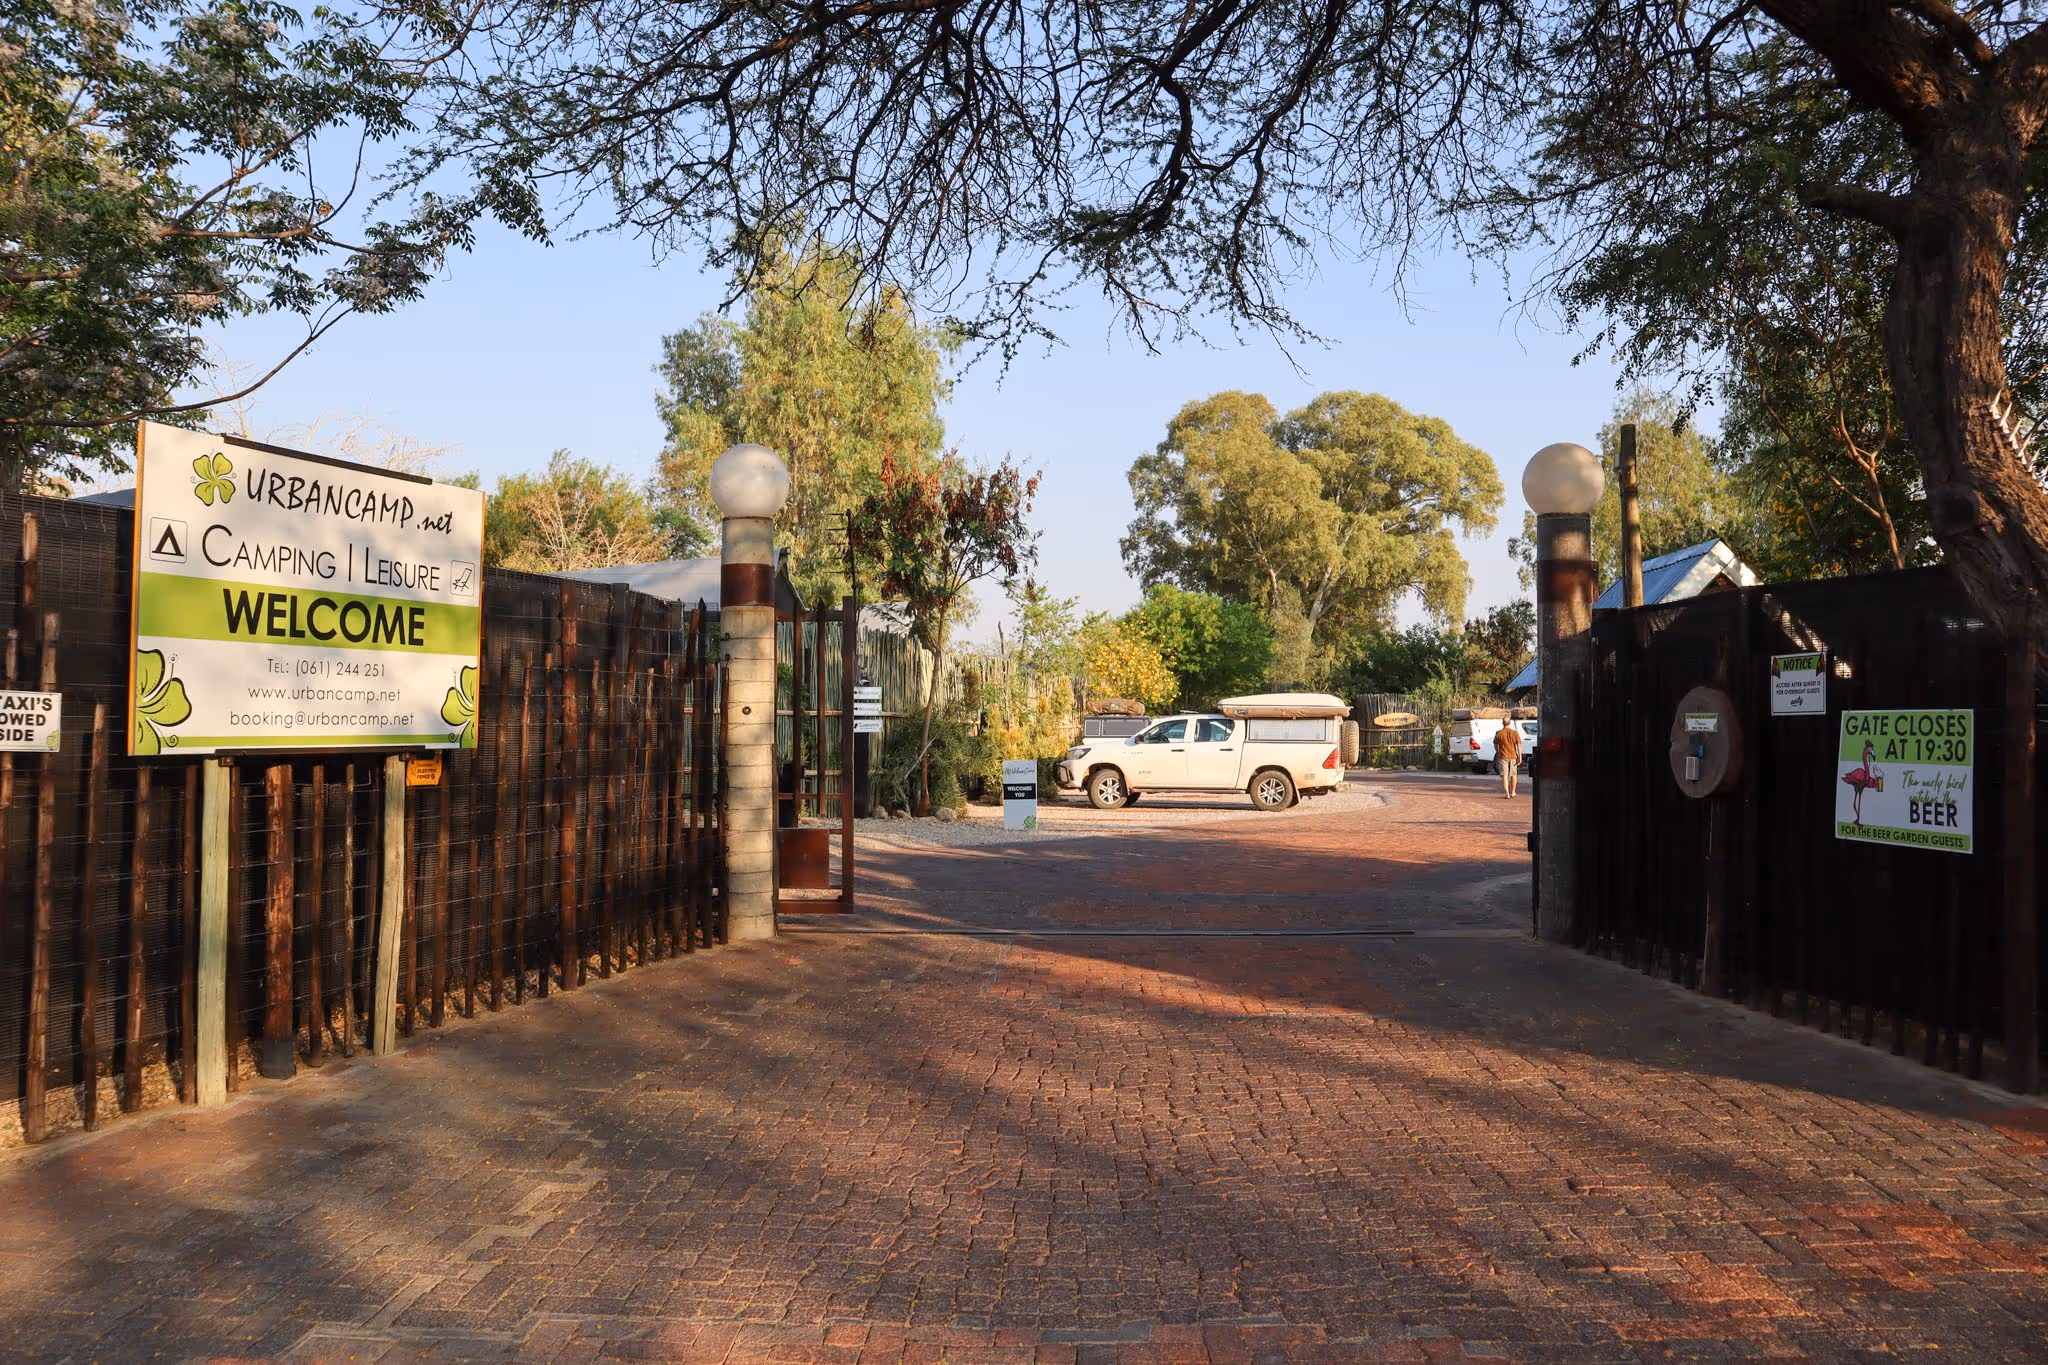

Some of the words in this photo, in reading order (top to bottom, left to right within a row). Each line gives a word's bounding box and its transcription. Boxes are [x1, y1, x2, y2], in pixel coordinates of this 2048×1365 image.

[246, 467, 454, 535] URBANCAMP.net
[222, 588, 425, 647] WELCOME
[296, 659, 331, 679] (061)
[336, 662, 360, 677] 244
[364, 663, 386, 677] 251
[1783, 657, 1813, 670] NOTICE
[0, 695, 52, 712] AXI'S
[247, 686, 401, 705] www.urbancamp.net
[1790, 695, 1804, 707] only
[230, 711, 415, 729] booking@urbancamp.net
[1845, 715, 1889, 736] GATE
[1894, 715, 1967, 737] CLOSES
[1885, 738, 1908, 760] AT
[1916, 738, 1966, 762] 19:30
[1902, 770, 1920, 789] The
[1946, 773, 1967, 792] bird
[1909, 800, 1959, 828] BEER
[1841, 825, 1857, 836] FOR
[1858, 827, 1873, 838] THE
[1872, 829, 1892, 841] BEER
[1892, 831, 1929, 844] GARDEN
[1931, 835, 1964, 849] GUESTS
